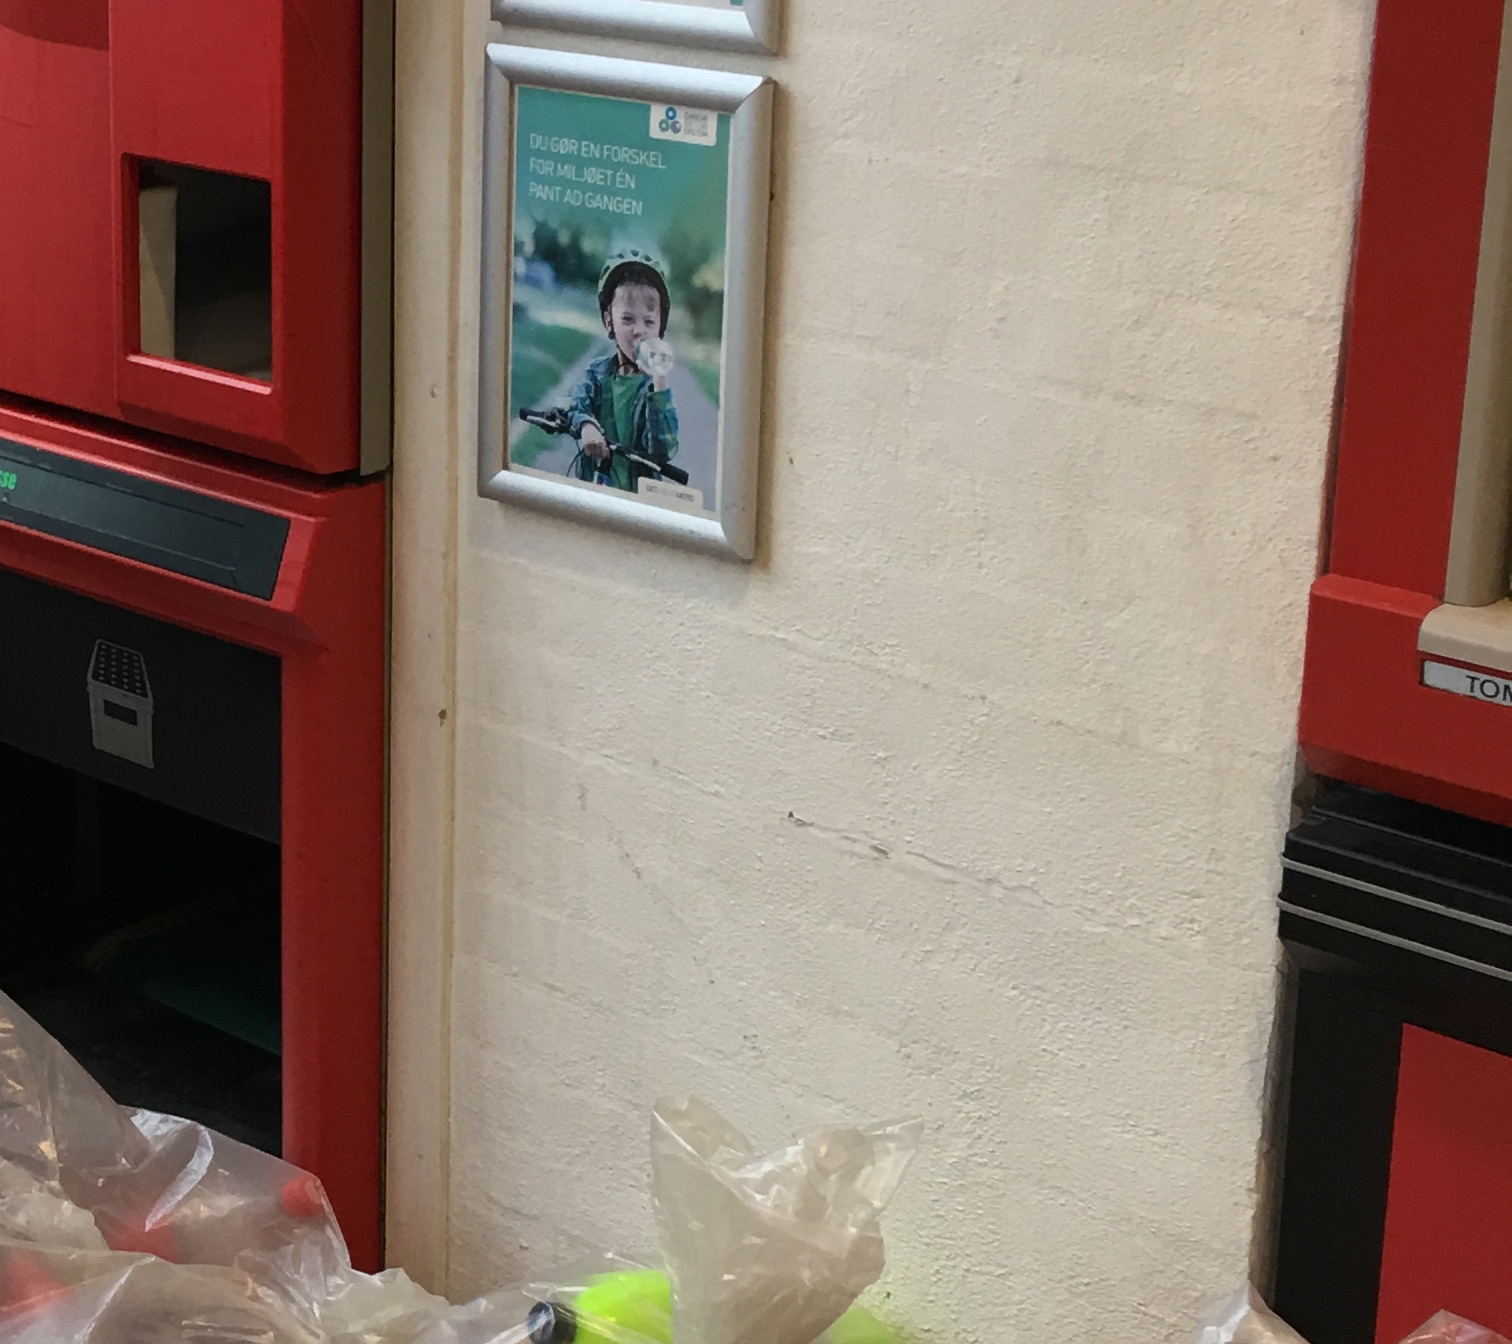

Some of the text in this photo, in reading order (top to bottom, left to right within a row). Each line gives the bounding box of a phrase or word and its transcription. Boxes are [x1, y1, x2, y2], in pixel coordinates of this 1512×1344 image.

[530, 133, 666, 169] DU GØR EN FORSKEL
[530, 157, 636, 190] FOR MILJØET ÉN
[528, 181, 642, 215] PANT AD GANGEN
